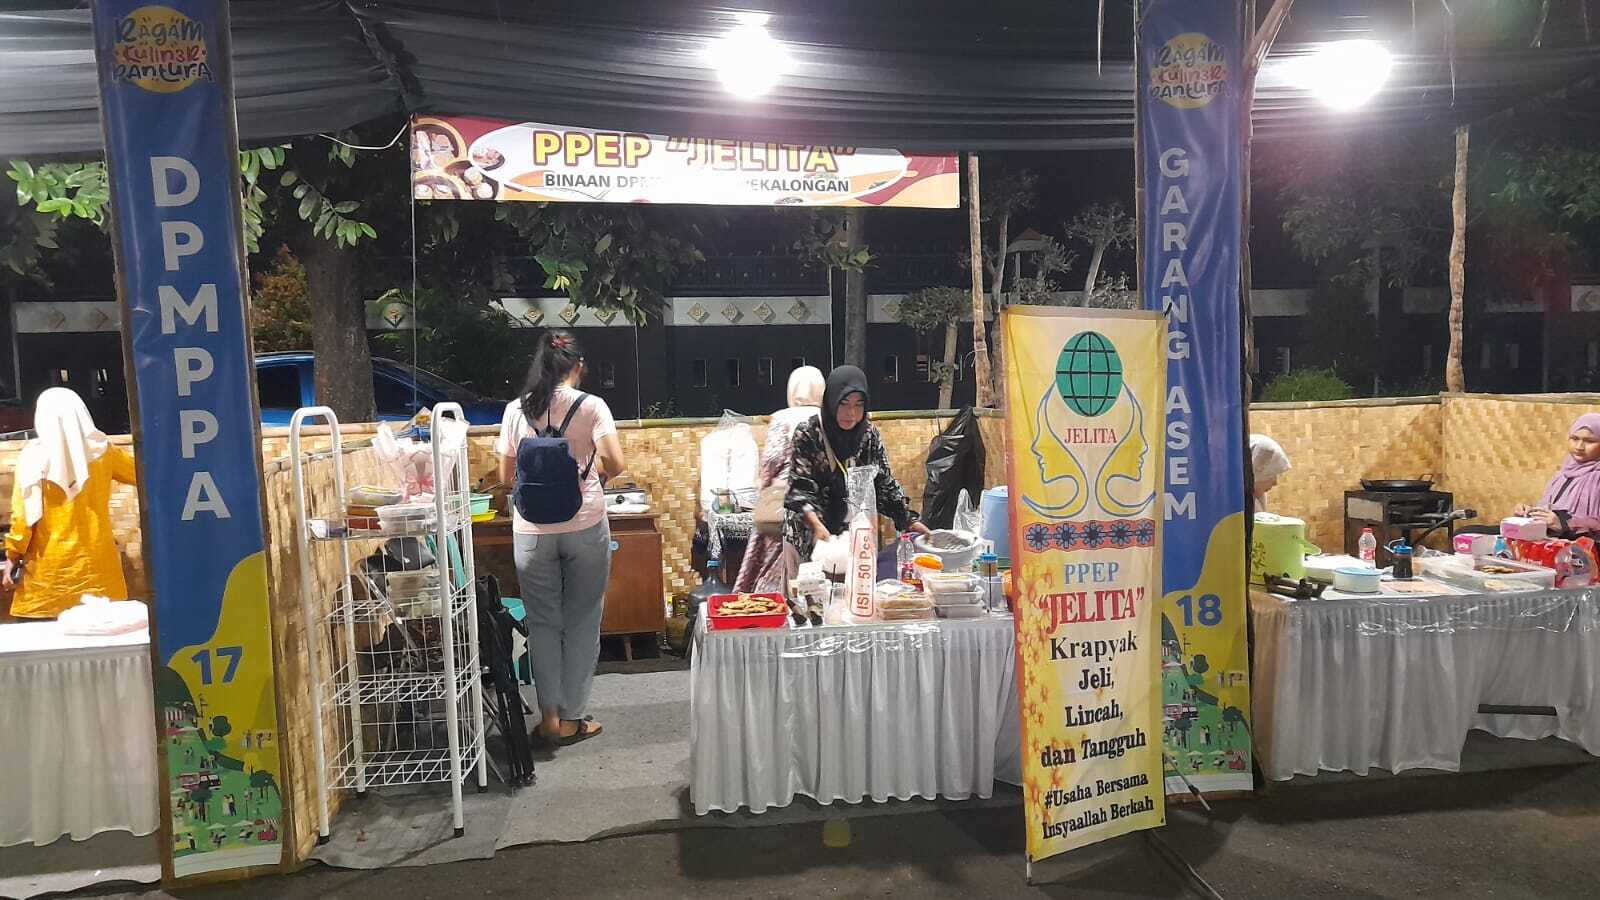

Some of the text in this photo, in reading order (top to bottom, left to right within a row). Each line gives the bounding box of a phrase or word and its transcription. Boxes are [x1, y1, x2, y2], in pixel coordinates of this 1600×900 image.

[532, 130, 652, 168] PPEP
[545, 174, 611, 187] BINAAN
[746, 178, 849, 192] EKALONGAN
[1159, 147, 1190, 360] GARANG
[150, 156, 232, 521] DPMPPA
[1064, 427, 1118, 444] JELITA
[1163, 385, 1198, 521] ASEM
[858, 564, 871, 579] 50
[1065, 562, 1119, 584] PPEP
[856, 592, 870, 609] ISI
[1039, 587, 1145, 634] “JELITA”
[1176, 594, 1222, 627] 18
[1050, 630, 1138, 662] Krapyak
[191, 646, 243, 685] 17
[1079, 667, 1115, 690] Jeli,
[1065, 699, 1123, 727] Lincah,
[1041, 728, 1147, 768] dan Tangguh
[1044, 773, 1148, 809] #Usaha Bersama
[1042, 795, 1154, 839] Insyaallah Berkah
